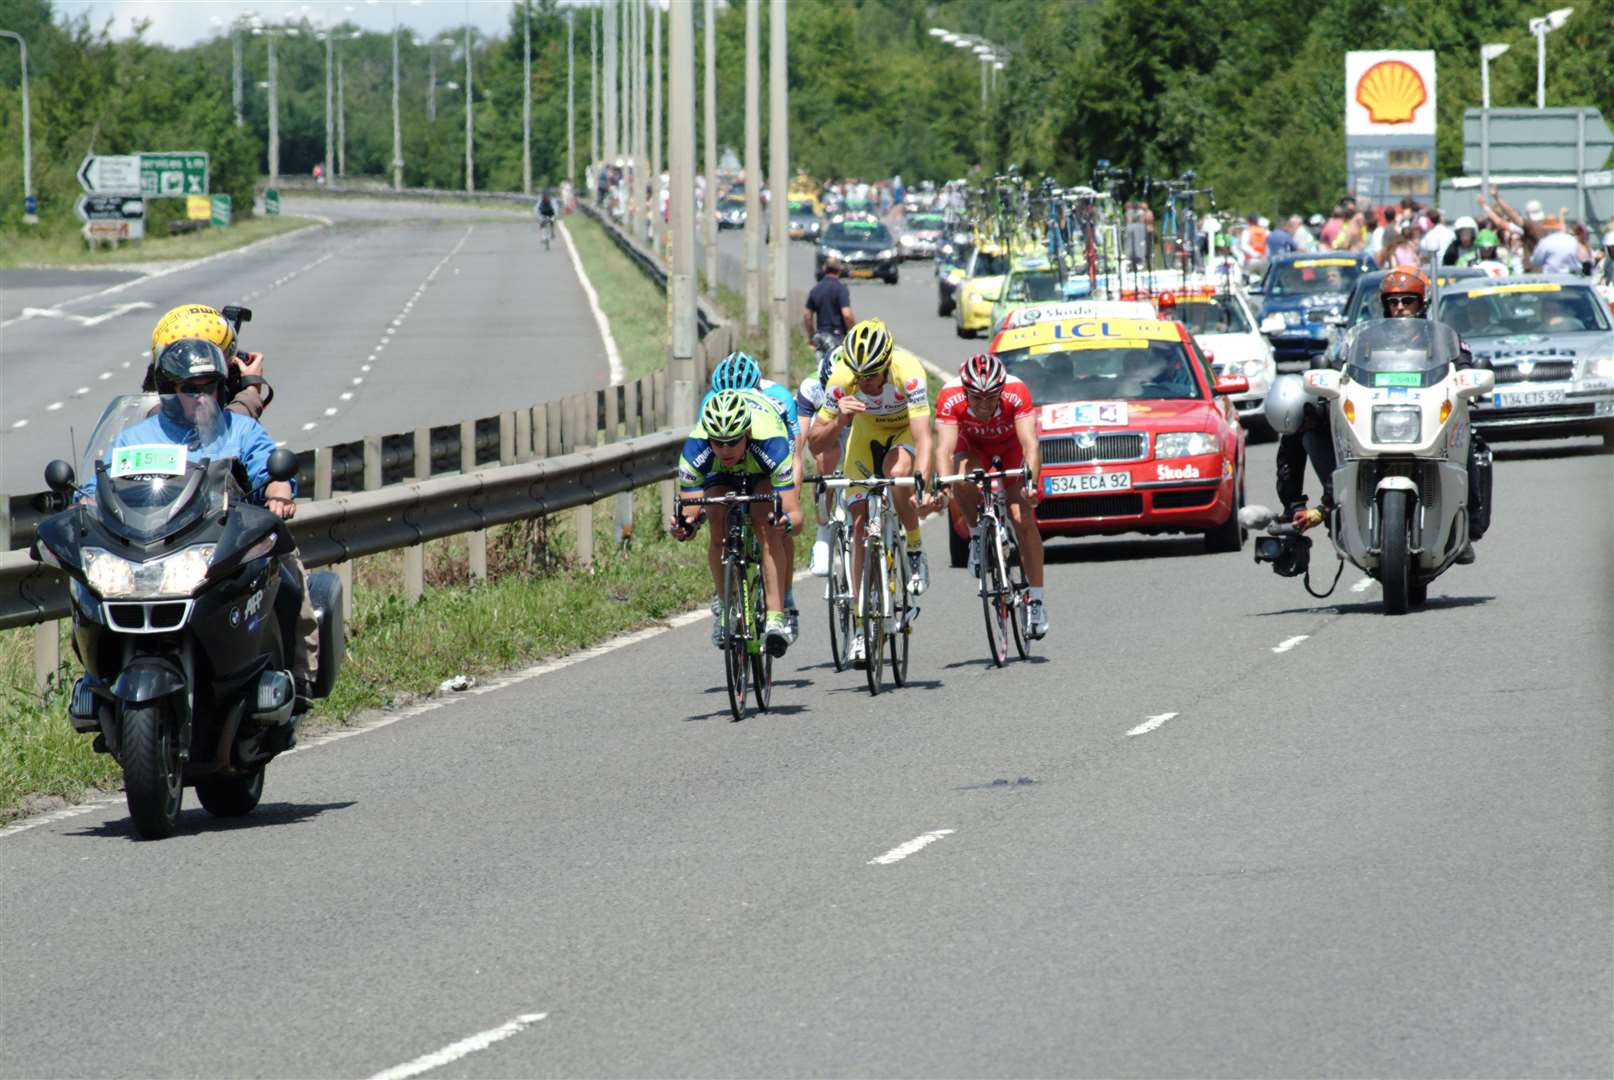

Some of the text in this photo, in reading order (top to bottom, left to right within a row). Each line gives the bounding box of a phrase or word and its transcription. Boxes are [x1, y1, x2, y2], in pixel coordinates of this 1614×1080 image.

[1055, 322, 1120, 339] LCL
[1547, 389, 1562, 402] 92
[1052, 473, 1128, 492] 534 ECA 92
